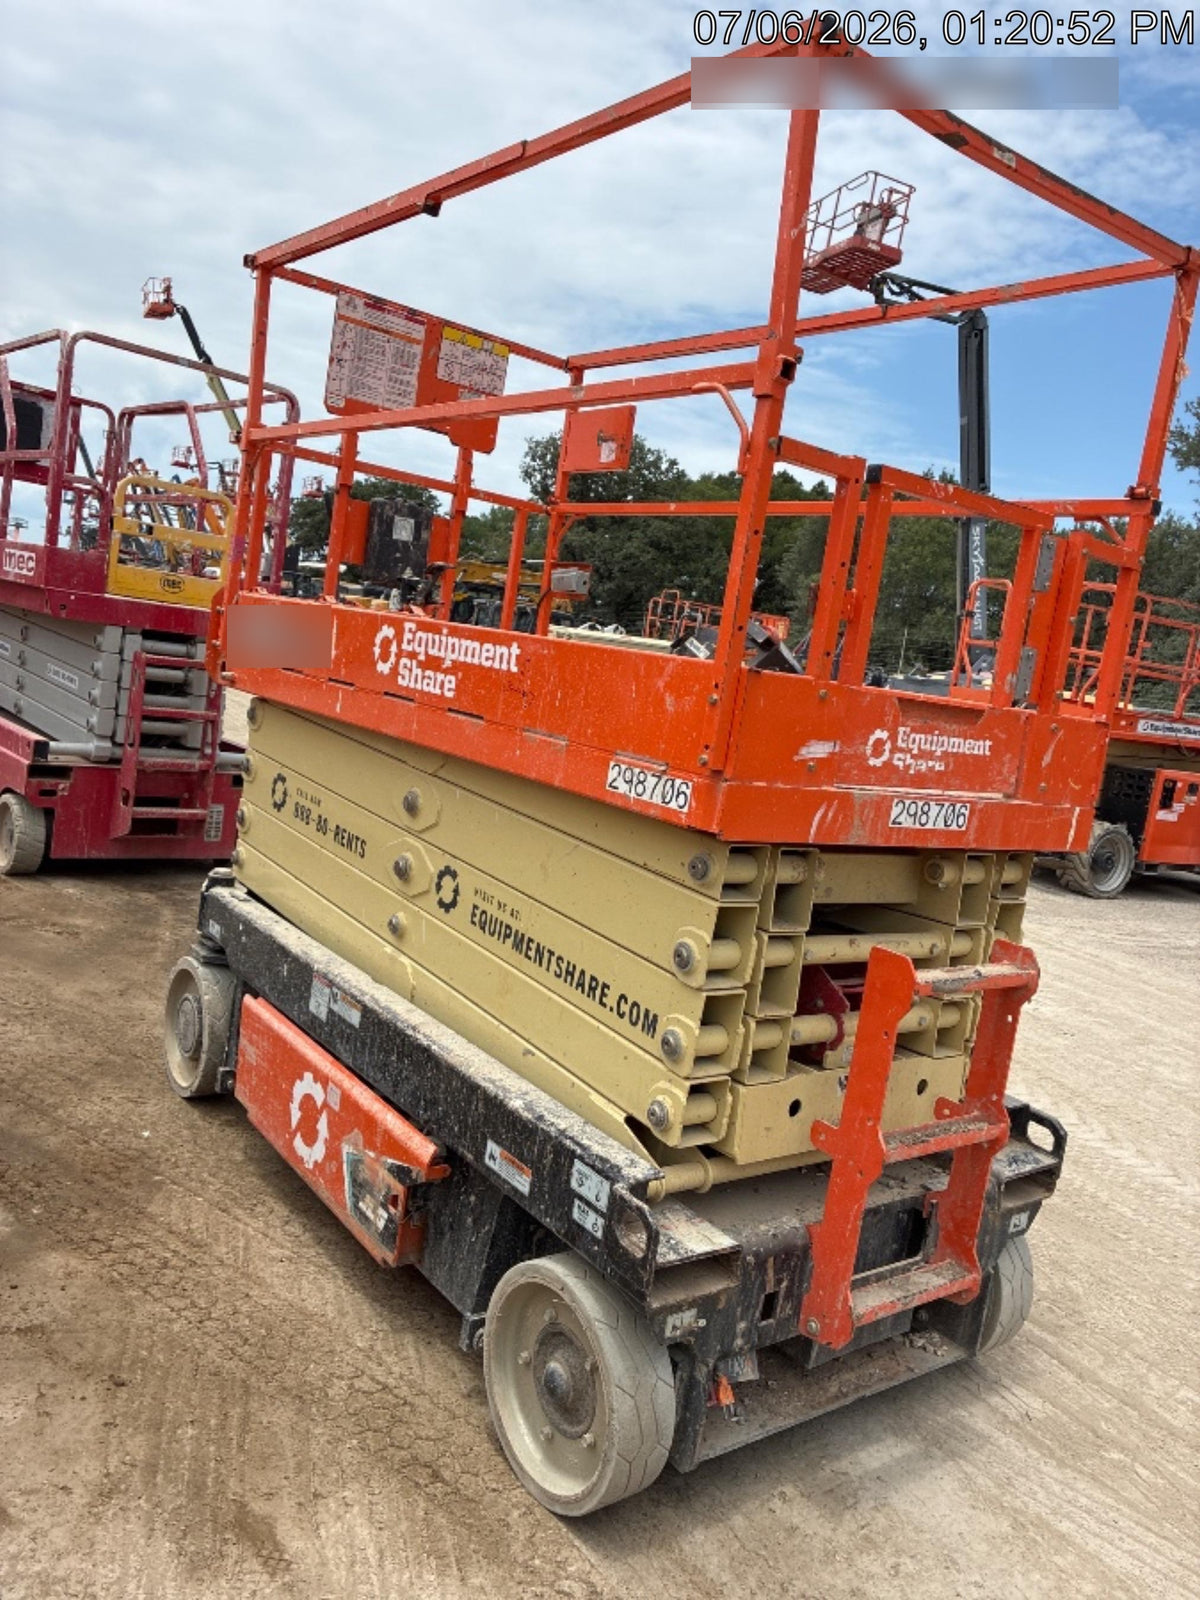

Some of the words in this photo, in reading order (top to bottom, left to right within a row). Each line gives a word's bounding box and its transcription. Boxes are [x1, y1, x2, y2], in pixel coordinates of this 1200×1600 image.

[401, 621, 521, 673] Equipment
[397, 657, 456, 698] Share
[896, 726, 992, 756] Equipment
[608, 763, 690, 809] 298706
[890, 799, 968, 829] 298706
[470, 903, 659, 1040] EQUIPMENTSHARE.COM
